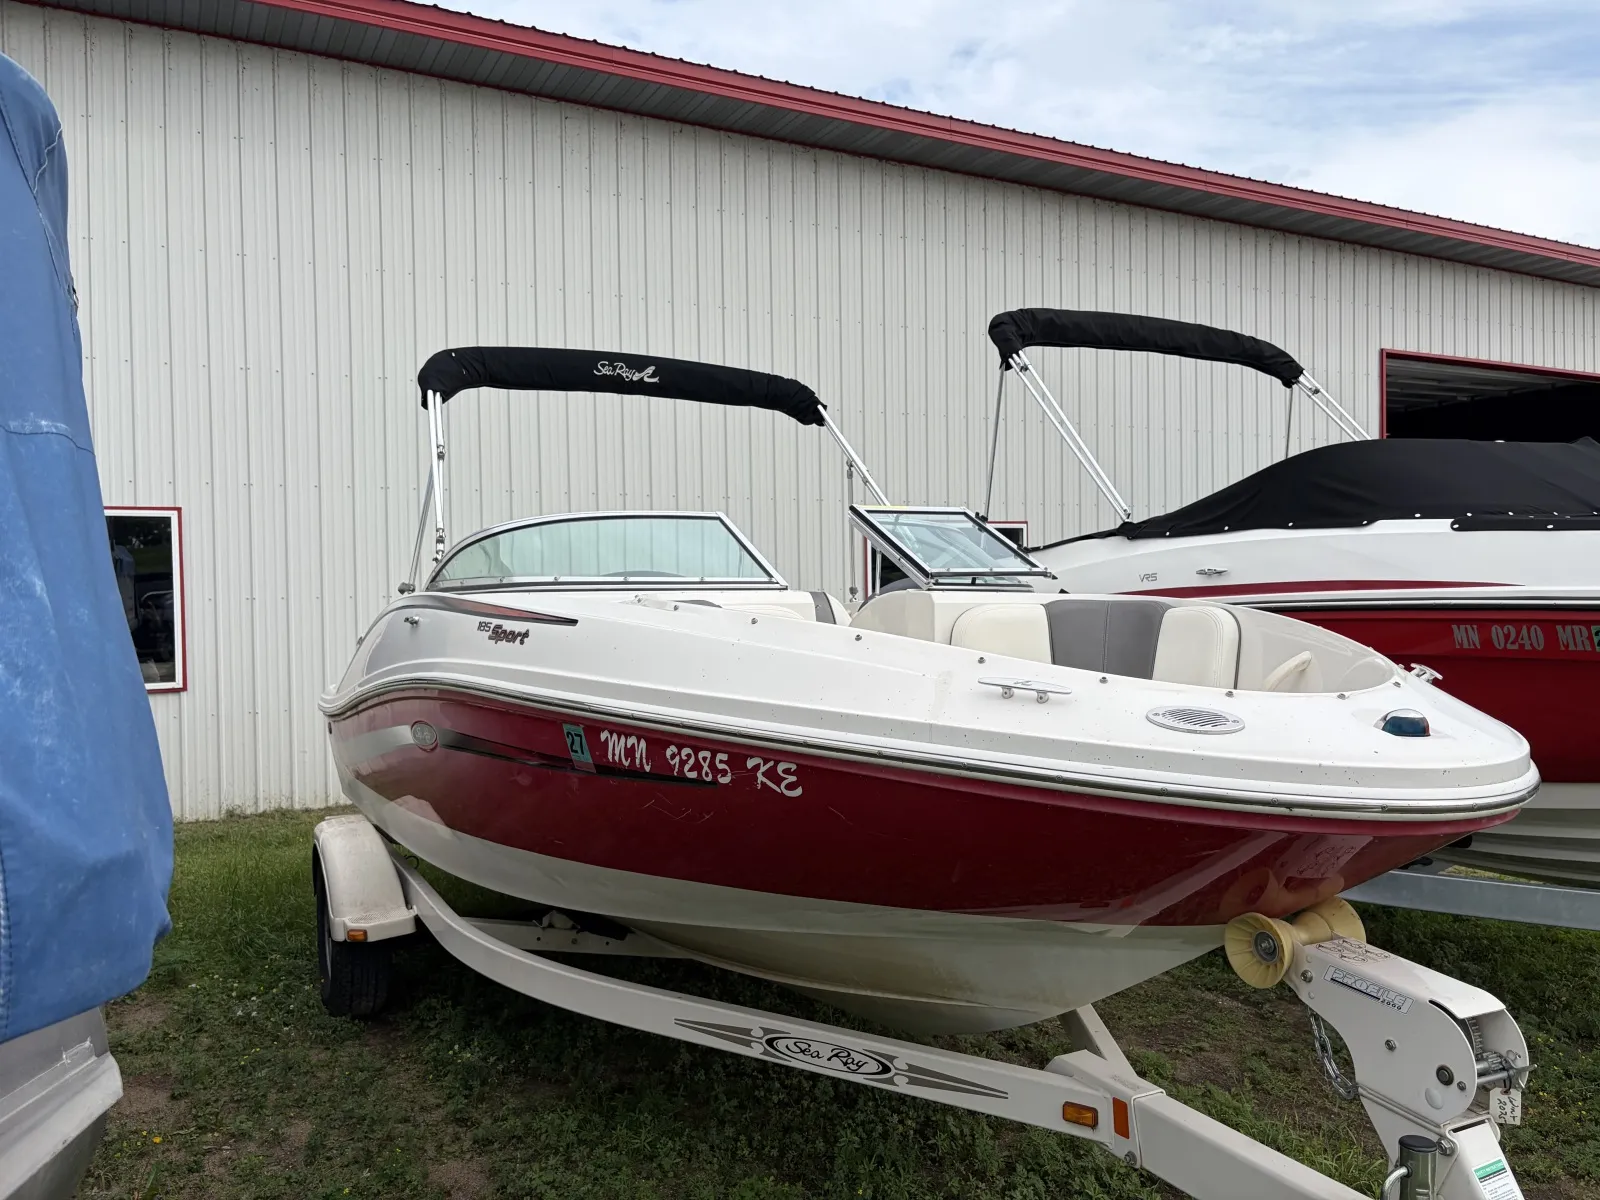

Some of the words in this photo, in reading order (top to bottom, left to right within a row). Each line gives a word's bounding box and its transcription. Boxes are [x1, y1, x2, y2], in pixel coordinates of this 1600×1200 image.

[593, 361, 614, 376] Sea
[613, 362, 635, 381] Ray
[477, 621, 492, 632] 185
[488, 624, 530, 645] Sport
[1451, 624, 1480, 649] MN
[1491, 624, 1545, 650] 0240
[1556, 624, 1592, 651] MR
[566, 731, 585, 755] 27
[600, 729, 652, 773] MN
[666, 744, 732, 784] 9285
[746, 756, 803, 798] KE
[1331, 967, 1408, 1008] PROFILE
[785, 1041, 824, 1059] Sea
[827, 1047, 869, 1071] Ray
